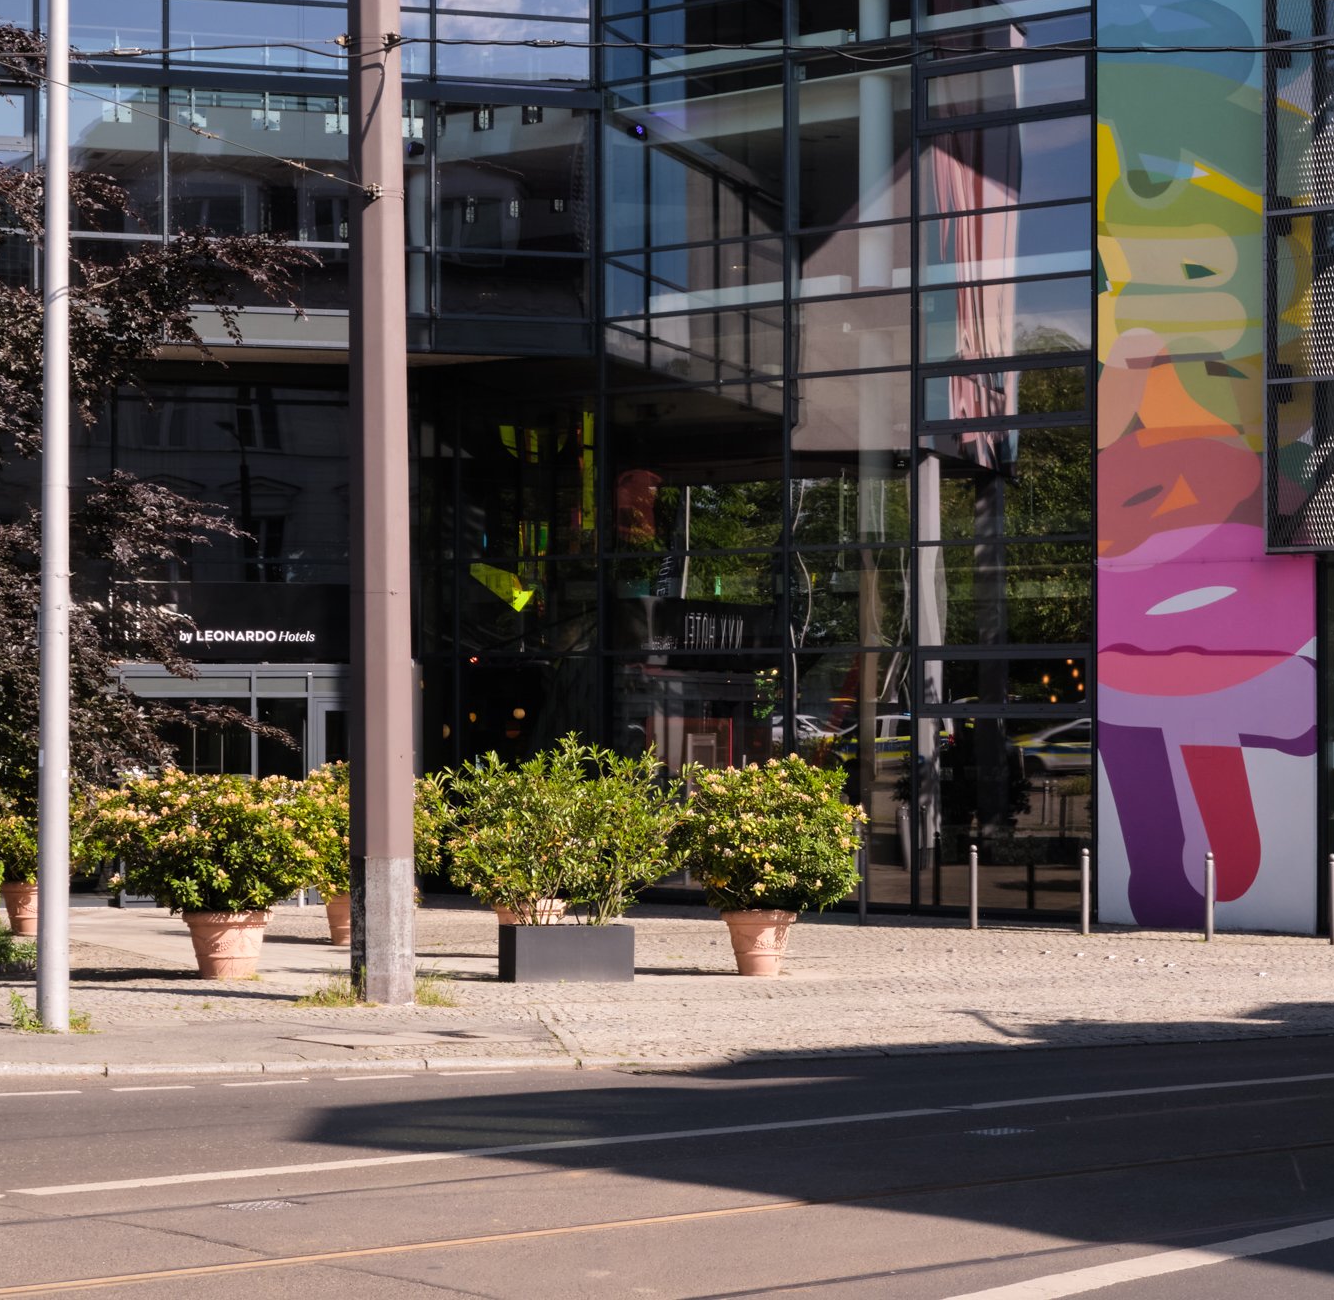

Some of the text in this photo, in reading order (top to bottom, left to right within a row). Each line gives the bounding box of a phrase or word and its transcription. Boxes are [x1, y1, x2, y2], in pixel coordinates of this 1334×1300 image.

[179, 630, 315, 644] by LEONARDO Hotels
